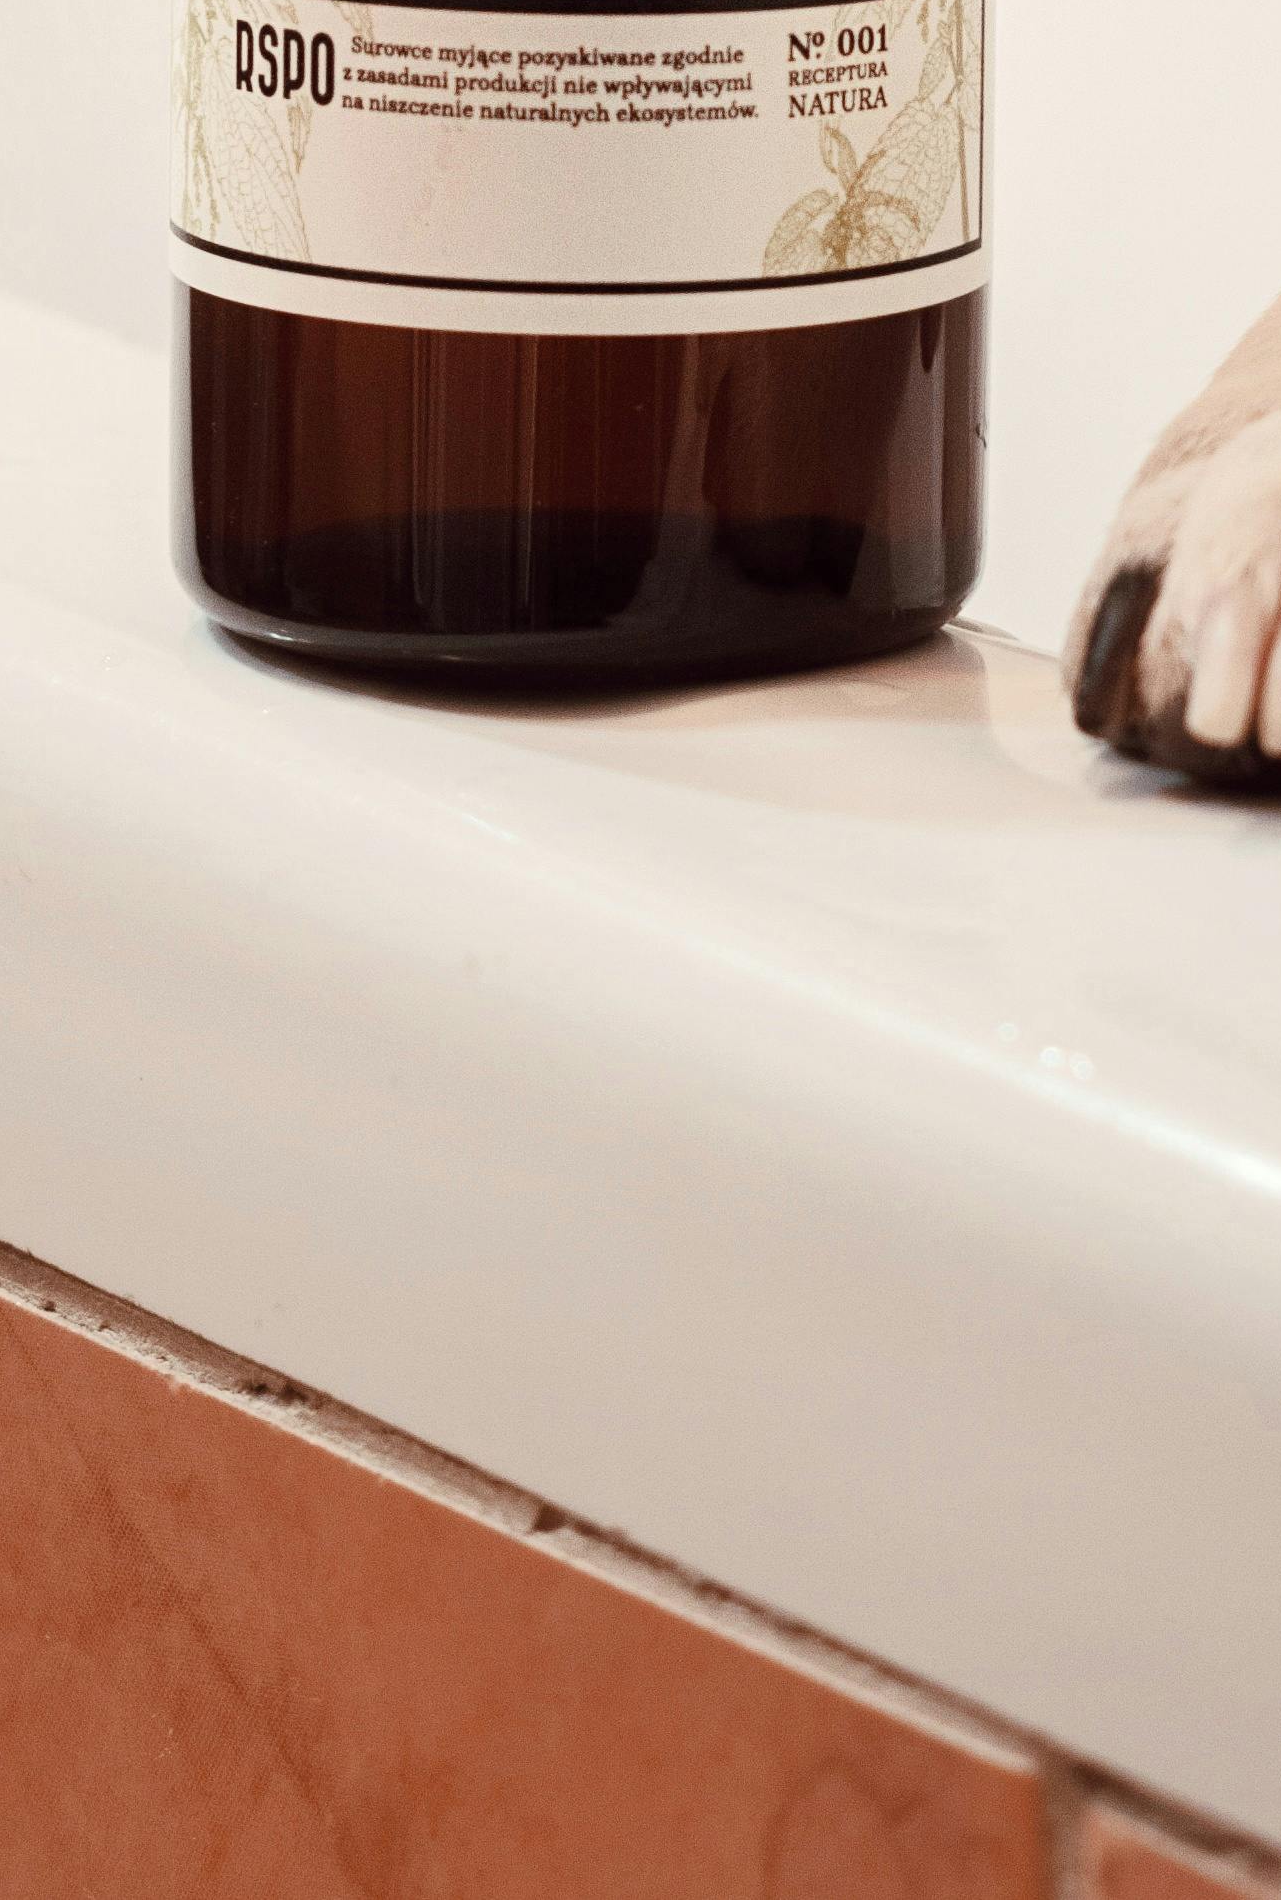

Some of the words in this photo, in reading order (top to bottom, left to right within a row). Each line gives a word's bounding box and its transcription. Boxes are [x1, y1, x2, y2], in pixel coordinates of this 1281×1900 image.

[351, 35, 433, 60] Surowce
[438, 43, 512, 70] myjące
[518, 45, 655, 72] pozyskiwane
[661, 44, 745, 71] zgodnie
[837, 23, 889, 57] 001
[235, 19, 336, 106] RSPO
[788, 61, 889, 87] RECEPTURA
[342, 66, 353, 82] z
[357, 67, 449, 90] zasadami
[455, 72, 558, 99] produkcji
[563, 74, 598, 95] nie
[603, 72, 754, 100] wpływającymi
[341, 93, 365, 110] na
[369, 93, 473, 119] niszczenie
[479, 100, 610, 128] naturalnych
[616, 99, 760, 128] ekosystemów.
[788, 85, 889, 118] NATURA
